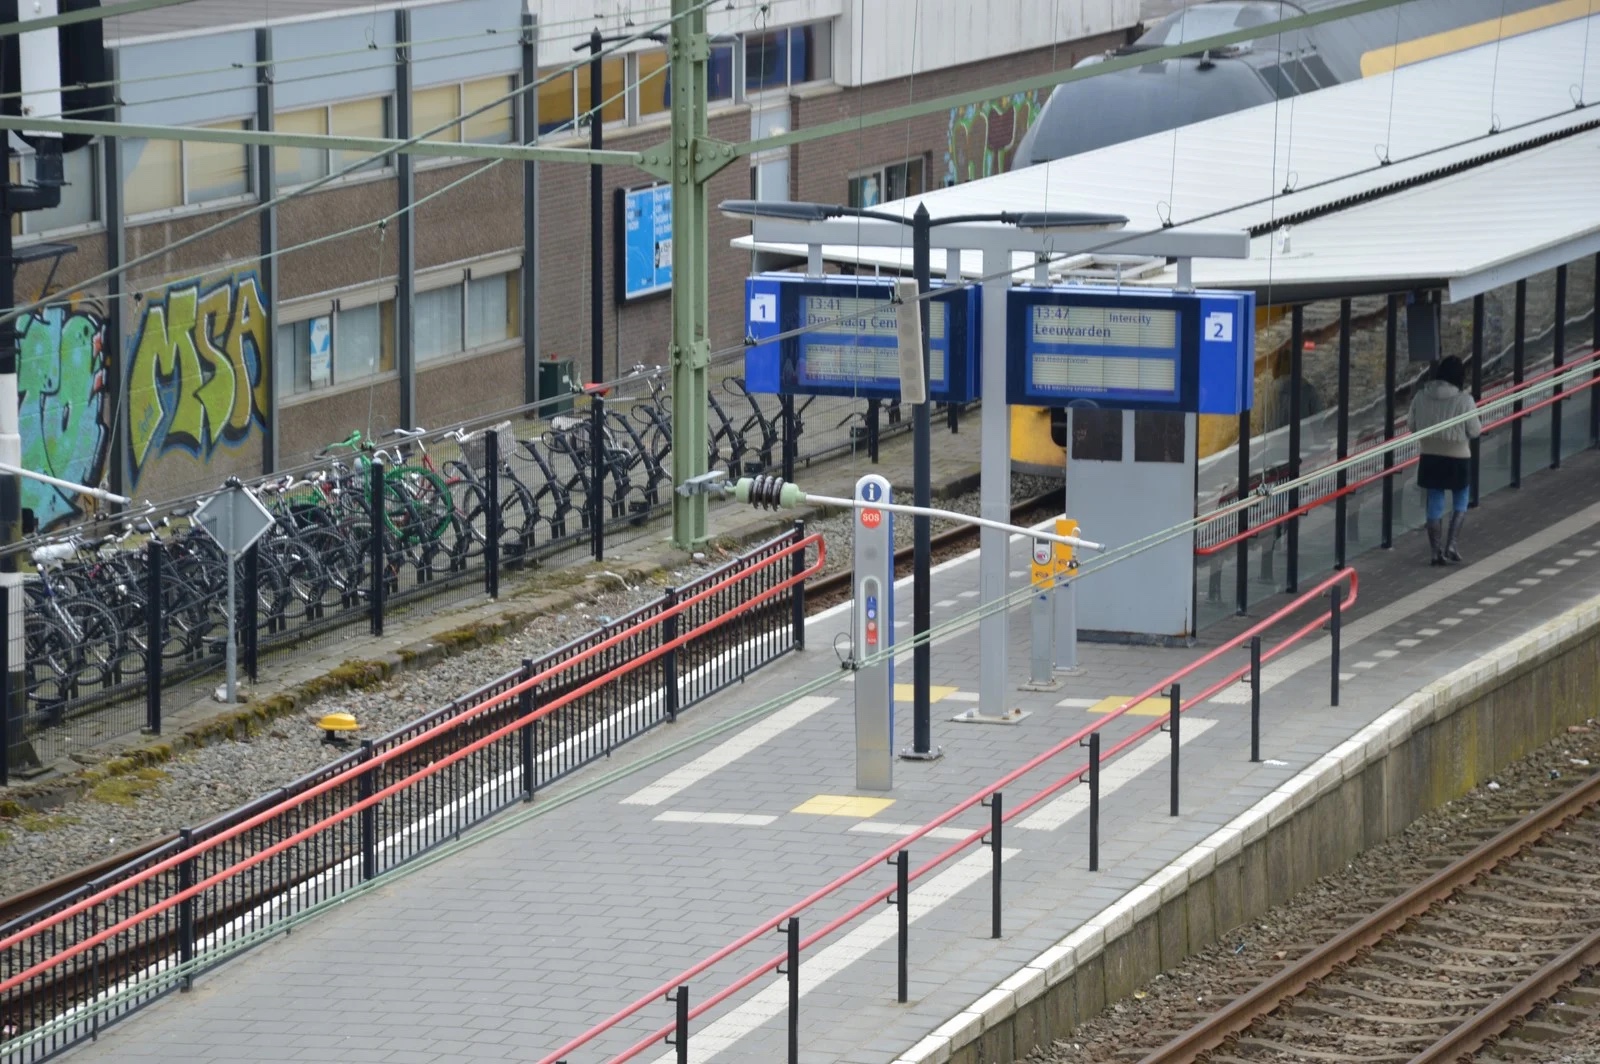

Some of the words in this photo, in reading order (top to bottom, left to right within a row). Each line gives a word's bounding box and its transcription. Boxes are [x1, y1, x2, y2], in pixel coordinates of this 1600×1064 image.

[759, 304, 766, 319] 1
[808, 297, 840, 312] 13:41
[1036, 307, 1069, 320] 13:47
[1109, 313, 1152, 325] Intercity
[1034, 323, 1111, 338] Leeuwarden
[1213, 322, 1224, 338] 2
[862, 513, 880, 522] SOS
